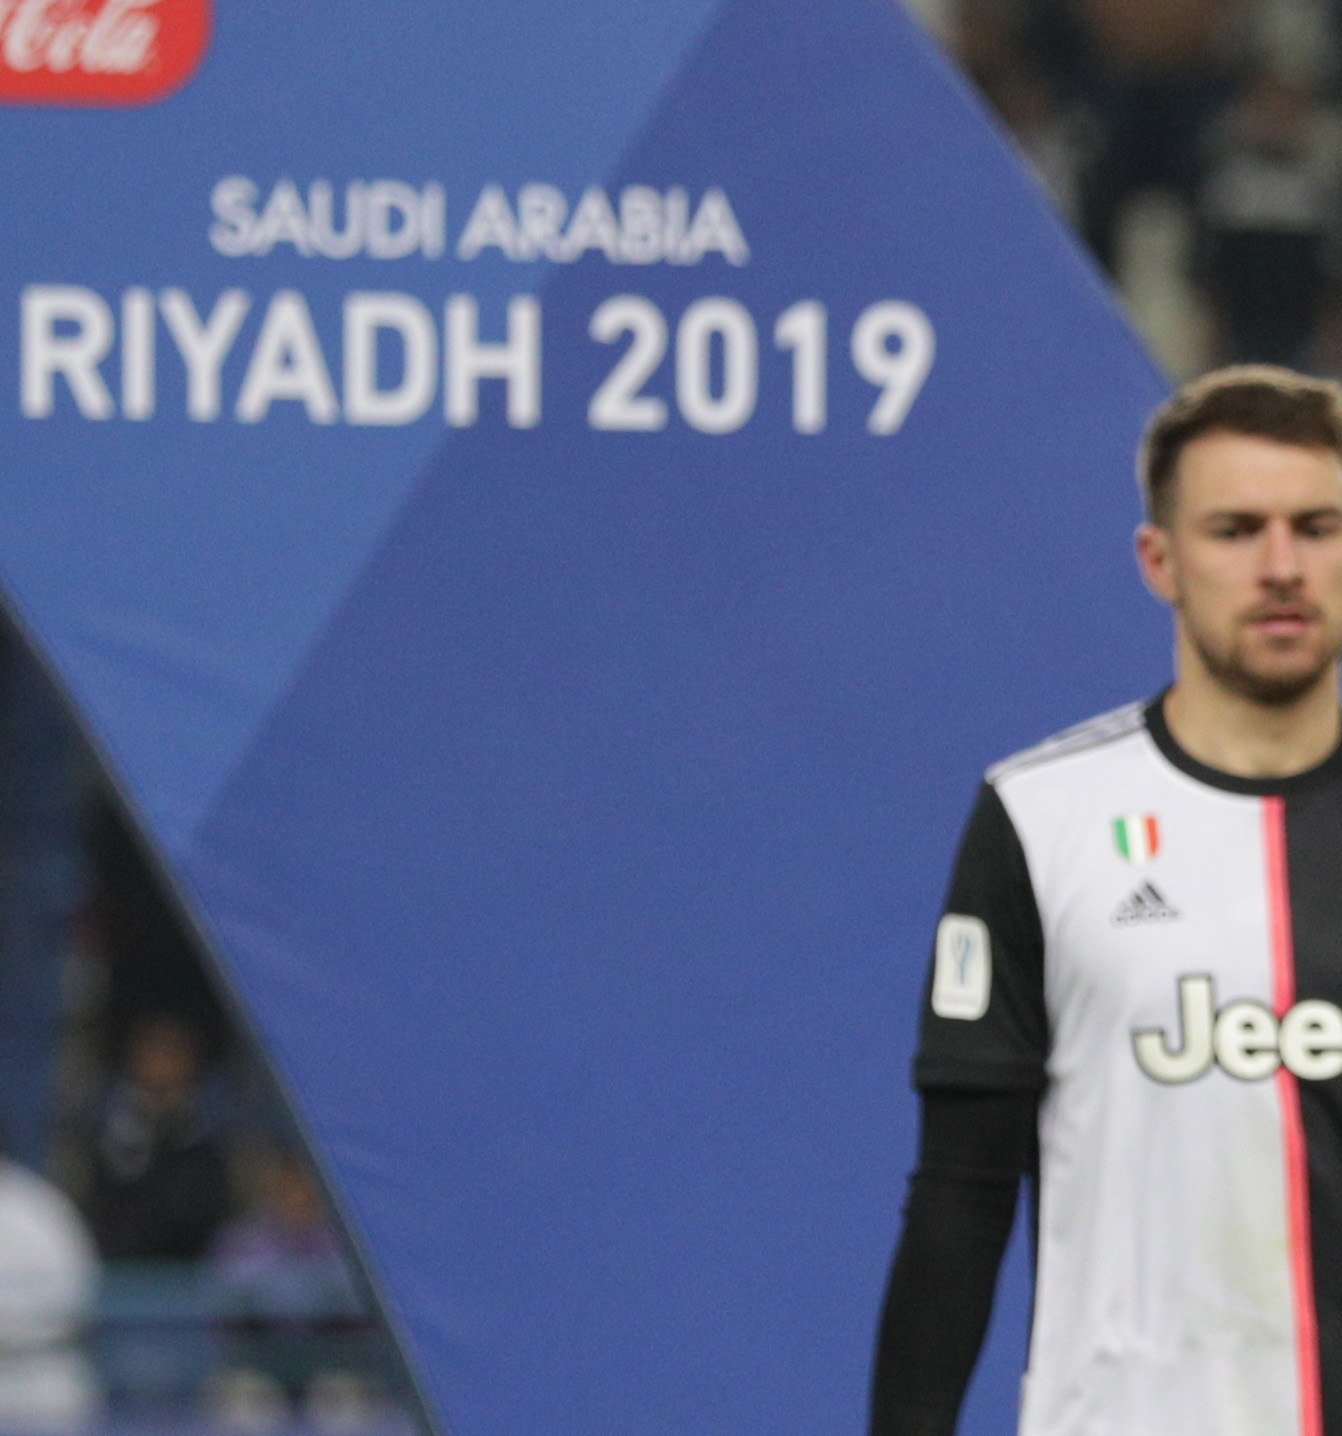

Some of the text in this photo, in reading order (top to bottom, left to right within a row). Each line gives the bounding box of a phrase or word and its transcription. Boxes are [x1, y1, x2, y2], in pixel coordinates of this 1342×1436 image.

[209, 177, 750, 267] SAUDI ARABIA
[19, 285, 936, 435] RIYADH 2019
